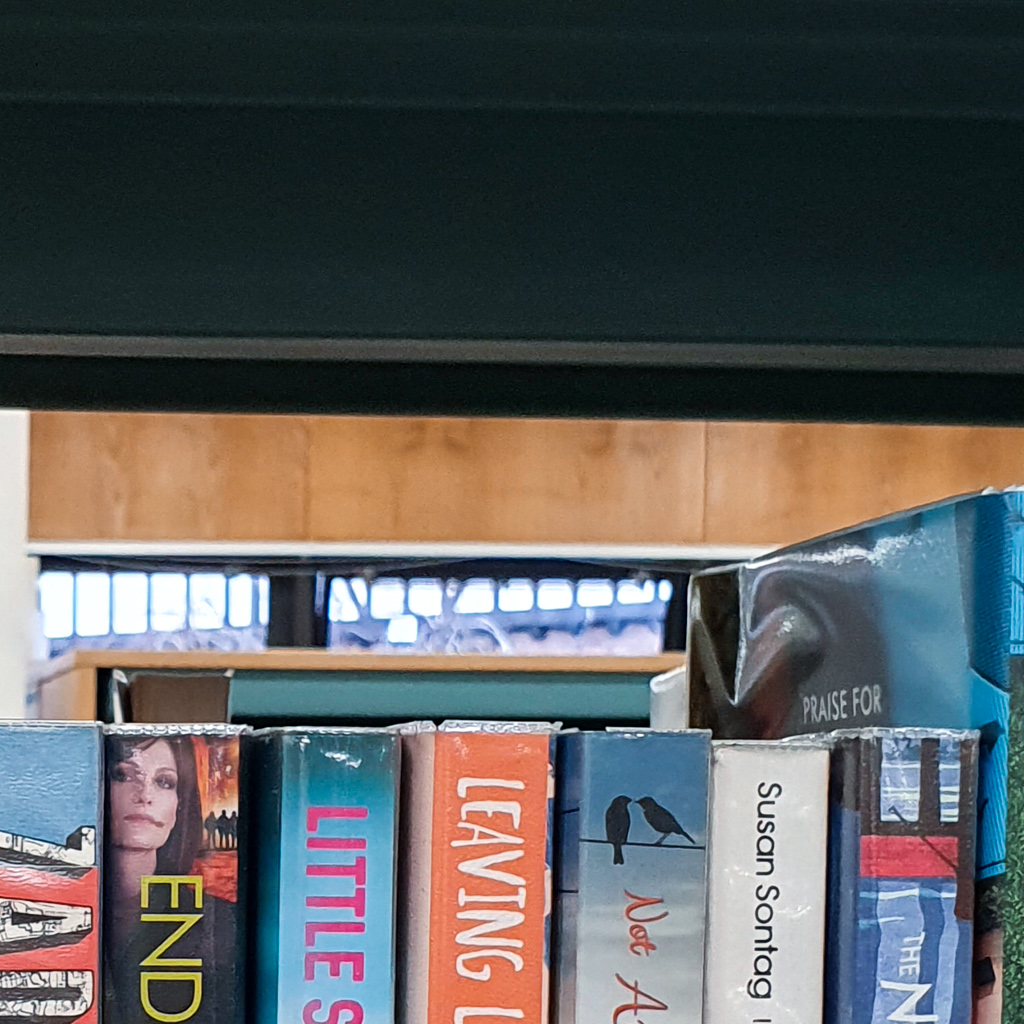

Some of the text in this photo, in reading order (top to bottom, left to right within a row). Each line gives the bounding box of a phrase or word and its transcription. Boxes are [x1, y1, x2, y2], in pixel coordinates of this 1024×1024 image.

[803, 683, 882, 724] PRAISE FOR
[138, 875, 205, 1024] END
[302, 805, 368, 982] LITTLE
[449, 776, 527, 981] LEAVING
[624, 889, 670, 957] Not
[746, 780, 783, 1000] Susan Sontag
[899, 931, 927, 977] THE
